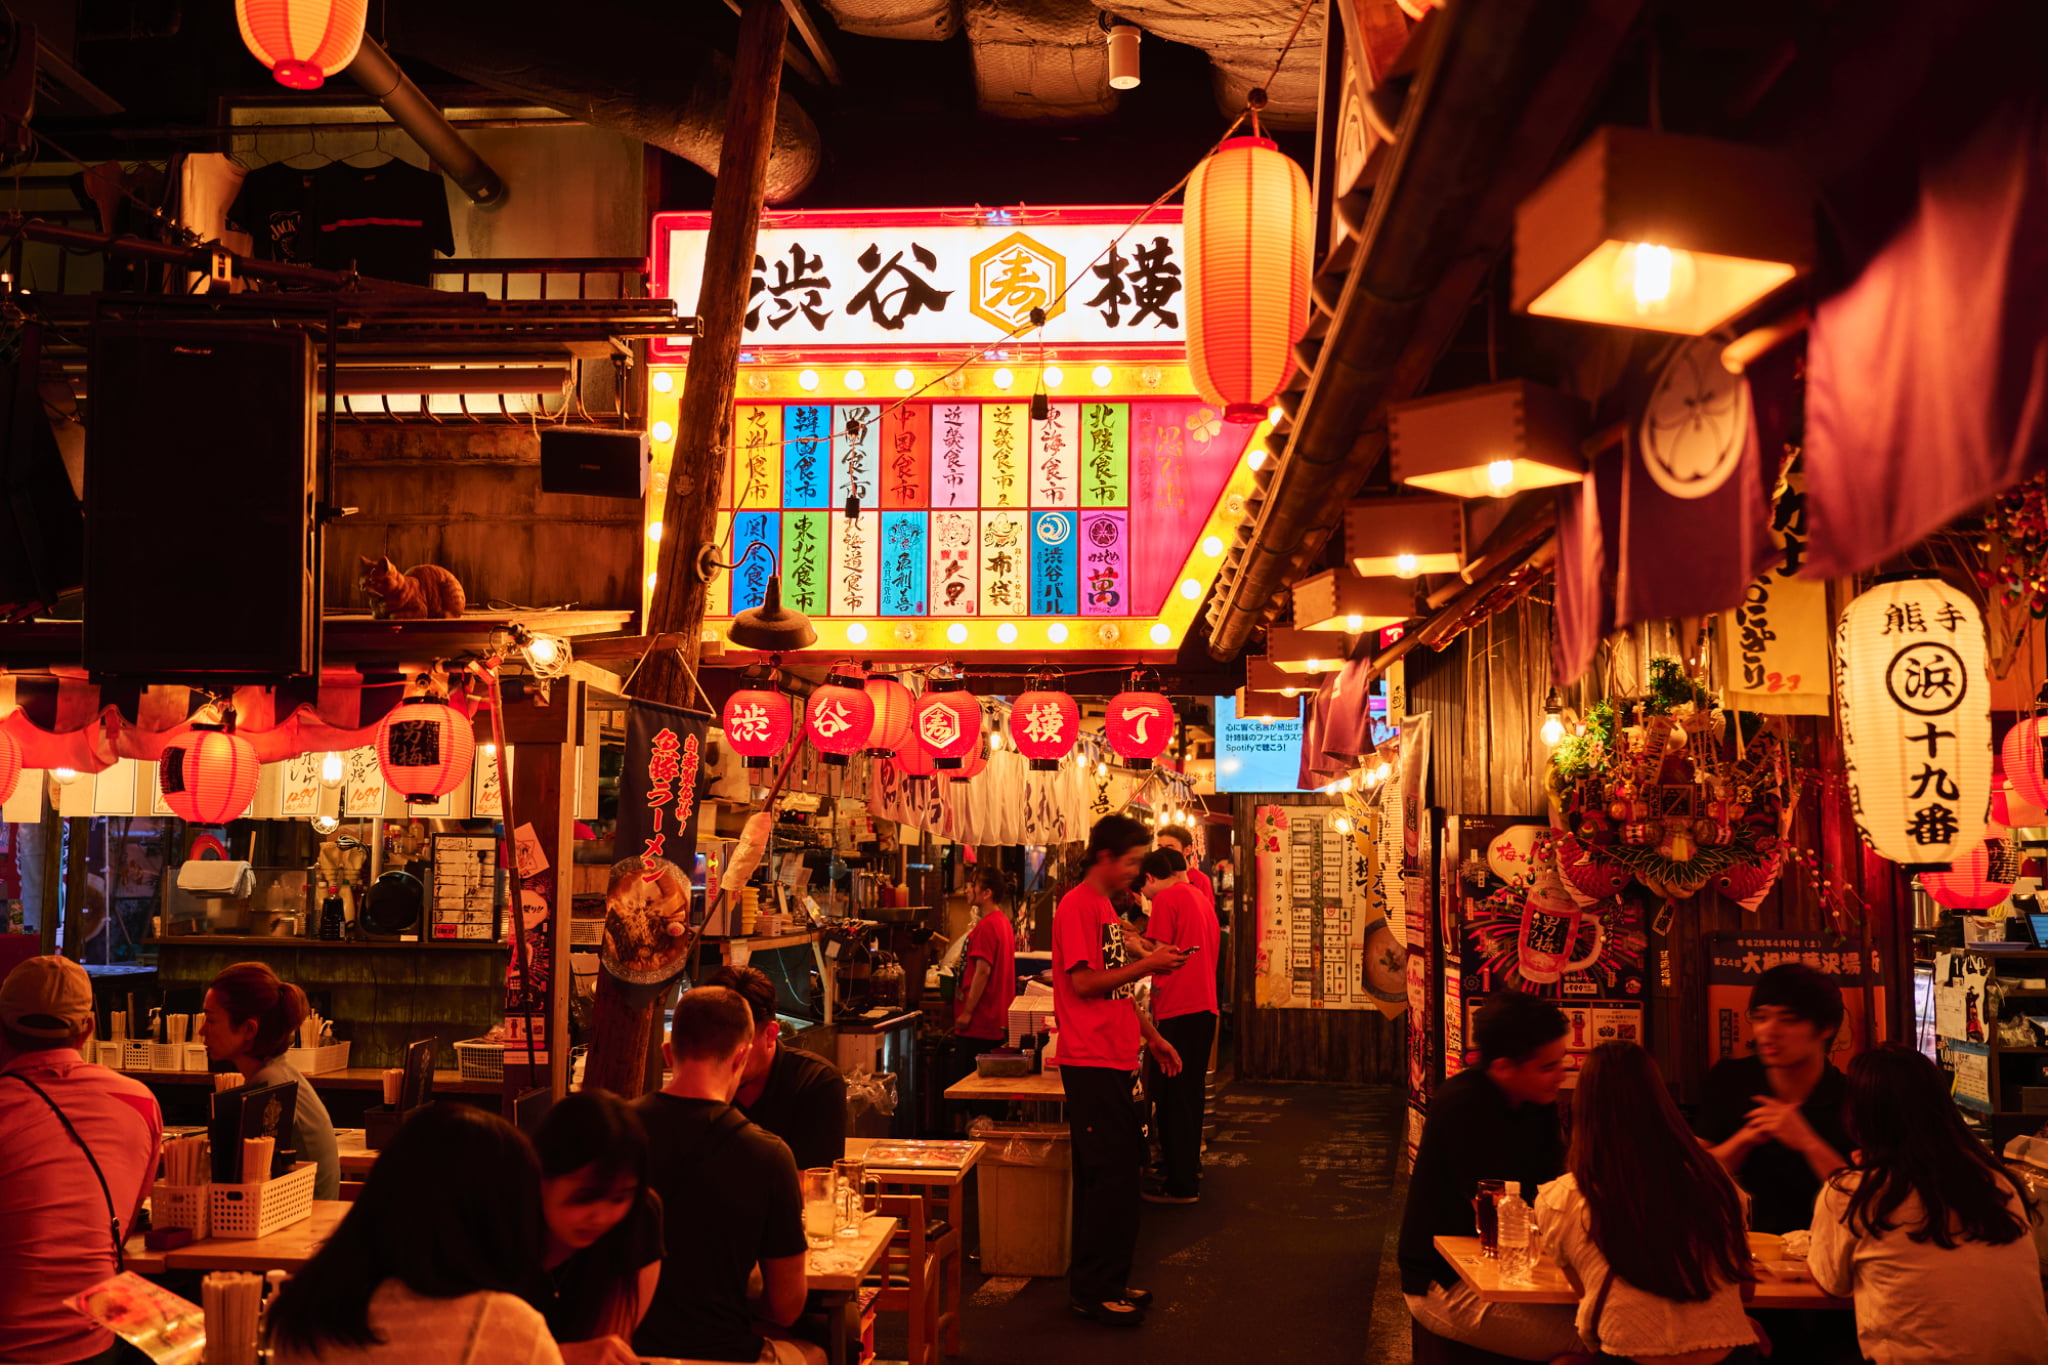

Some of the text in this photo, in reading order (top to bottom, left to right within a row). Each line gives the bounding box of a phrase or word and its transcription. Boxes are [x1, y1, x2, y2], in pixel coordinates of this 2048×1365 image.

[745, 407, 770, 505] 九州食市
[793, 406, 820, 505] 韓国食市
[890, 406, 920, 504] 中国食市
[1040, 404, 1068, 505] 東海食市
[1089, 404, 1118, 505] 北陸食市
[792, 514, 817, 613] 東北食市
[985, 550, 1013, 607] 布袋
[1043, 547, 1064, 615] 渋谷バル
[1881, 602, 1967, 635] 熊手
[1905, 654, 1956, 699] 浜
[730, 702, 771, 742] 渋
[811, 699, 852, 737] 谷
[1022, 702, 1065, 744] 横
[1120, 706, 1161, 745] 丁
[1905, 722, 1960, 845] 十九番
[1535, 915, 1560, 954] 男梅
